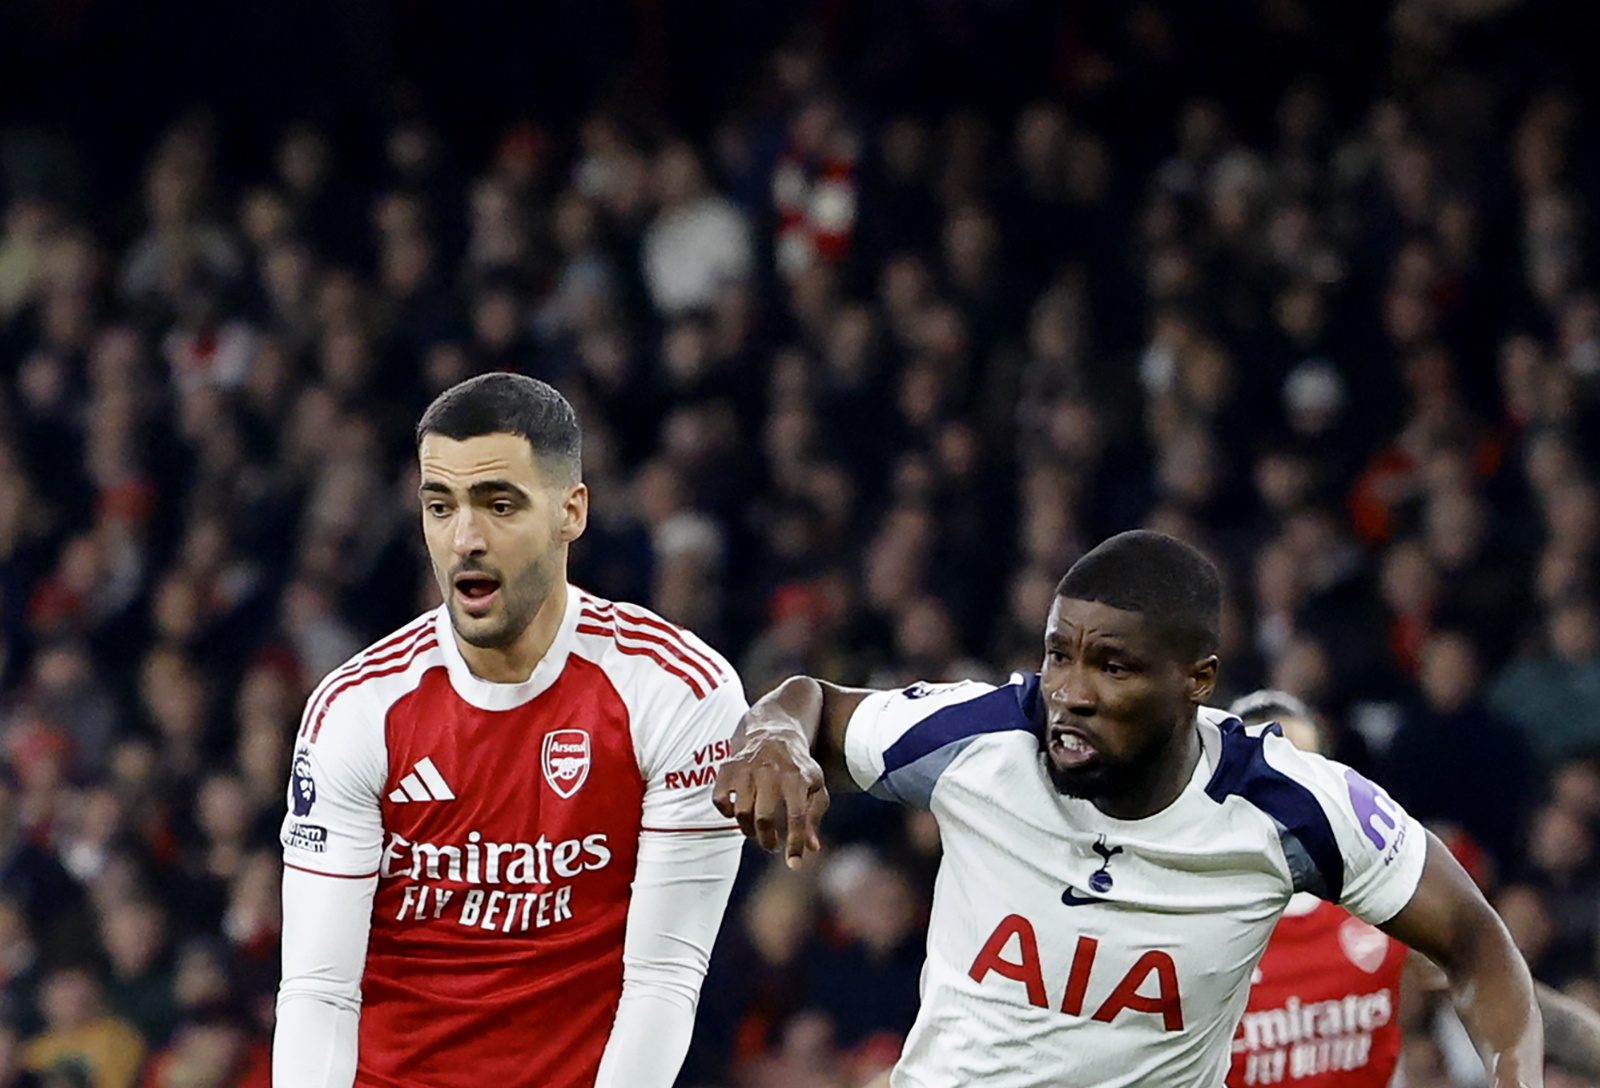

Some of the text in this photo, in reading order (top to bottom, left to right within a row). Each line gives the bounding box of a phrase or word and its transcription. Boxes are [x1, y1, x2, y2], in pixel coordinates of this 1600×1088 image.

[693, 739, 731, 765] VISI
[665, 766, 717, 789] RWA
[380, 831, 612, 884] Emirates
[396, 885, 573, 933] FLY BETTER
[968, 914, 1184, 1031] AIA
[1231, 987, 1392, 1053] mirates
